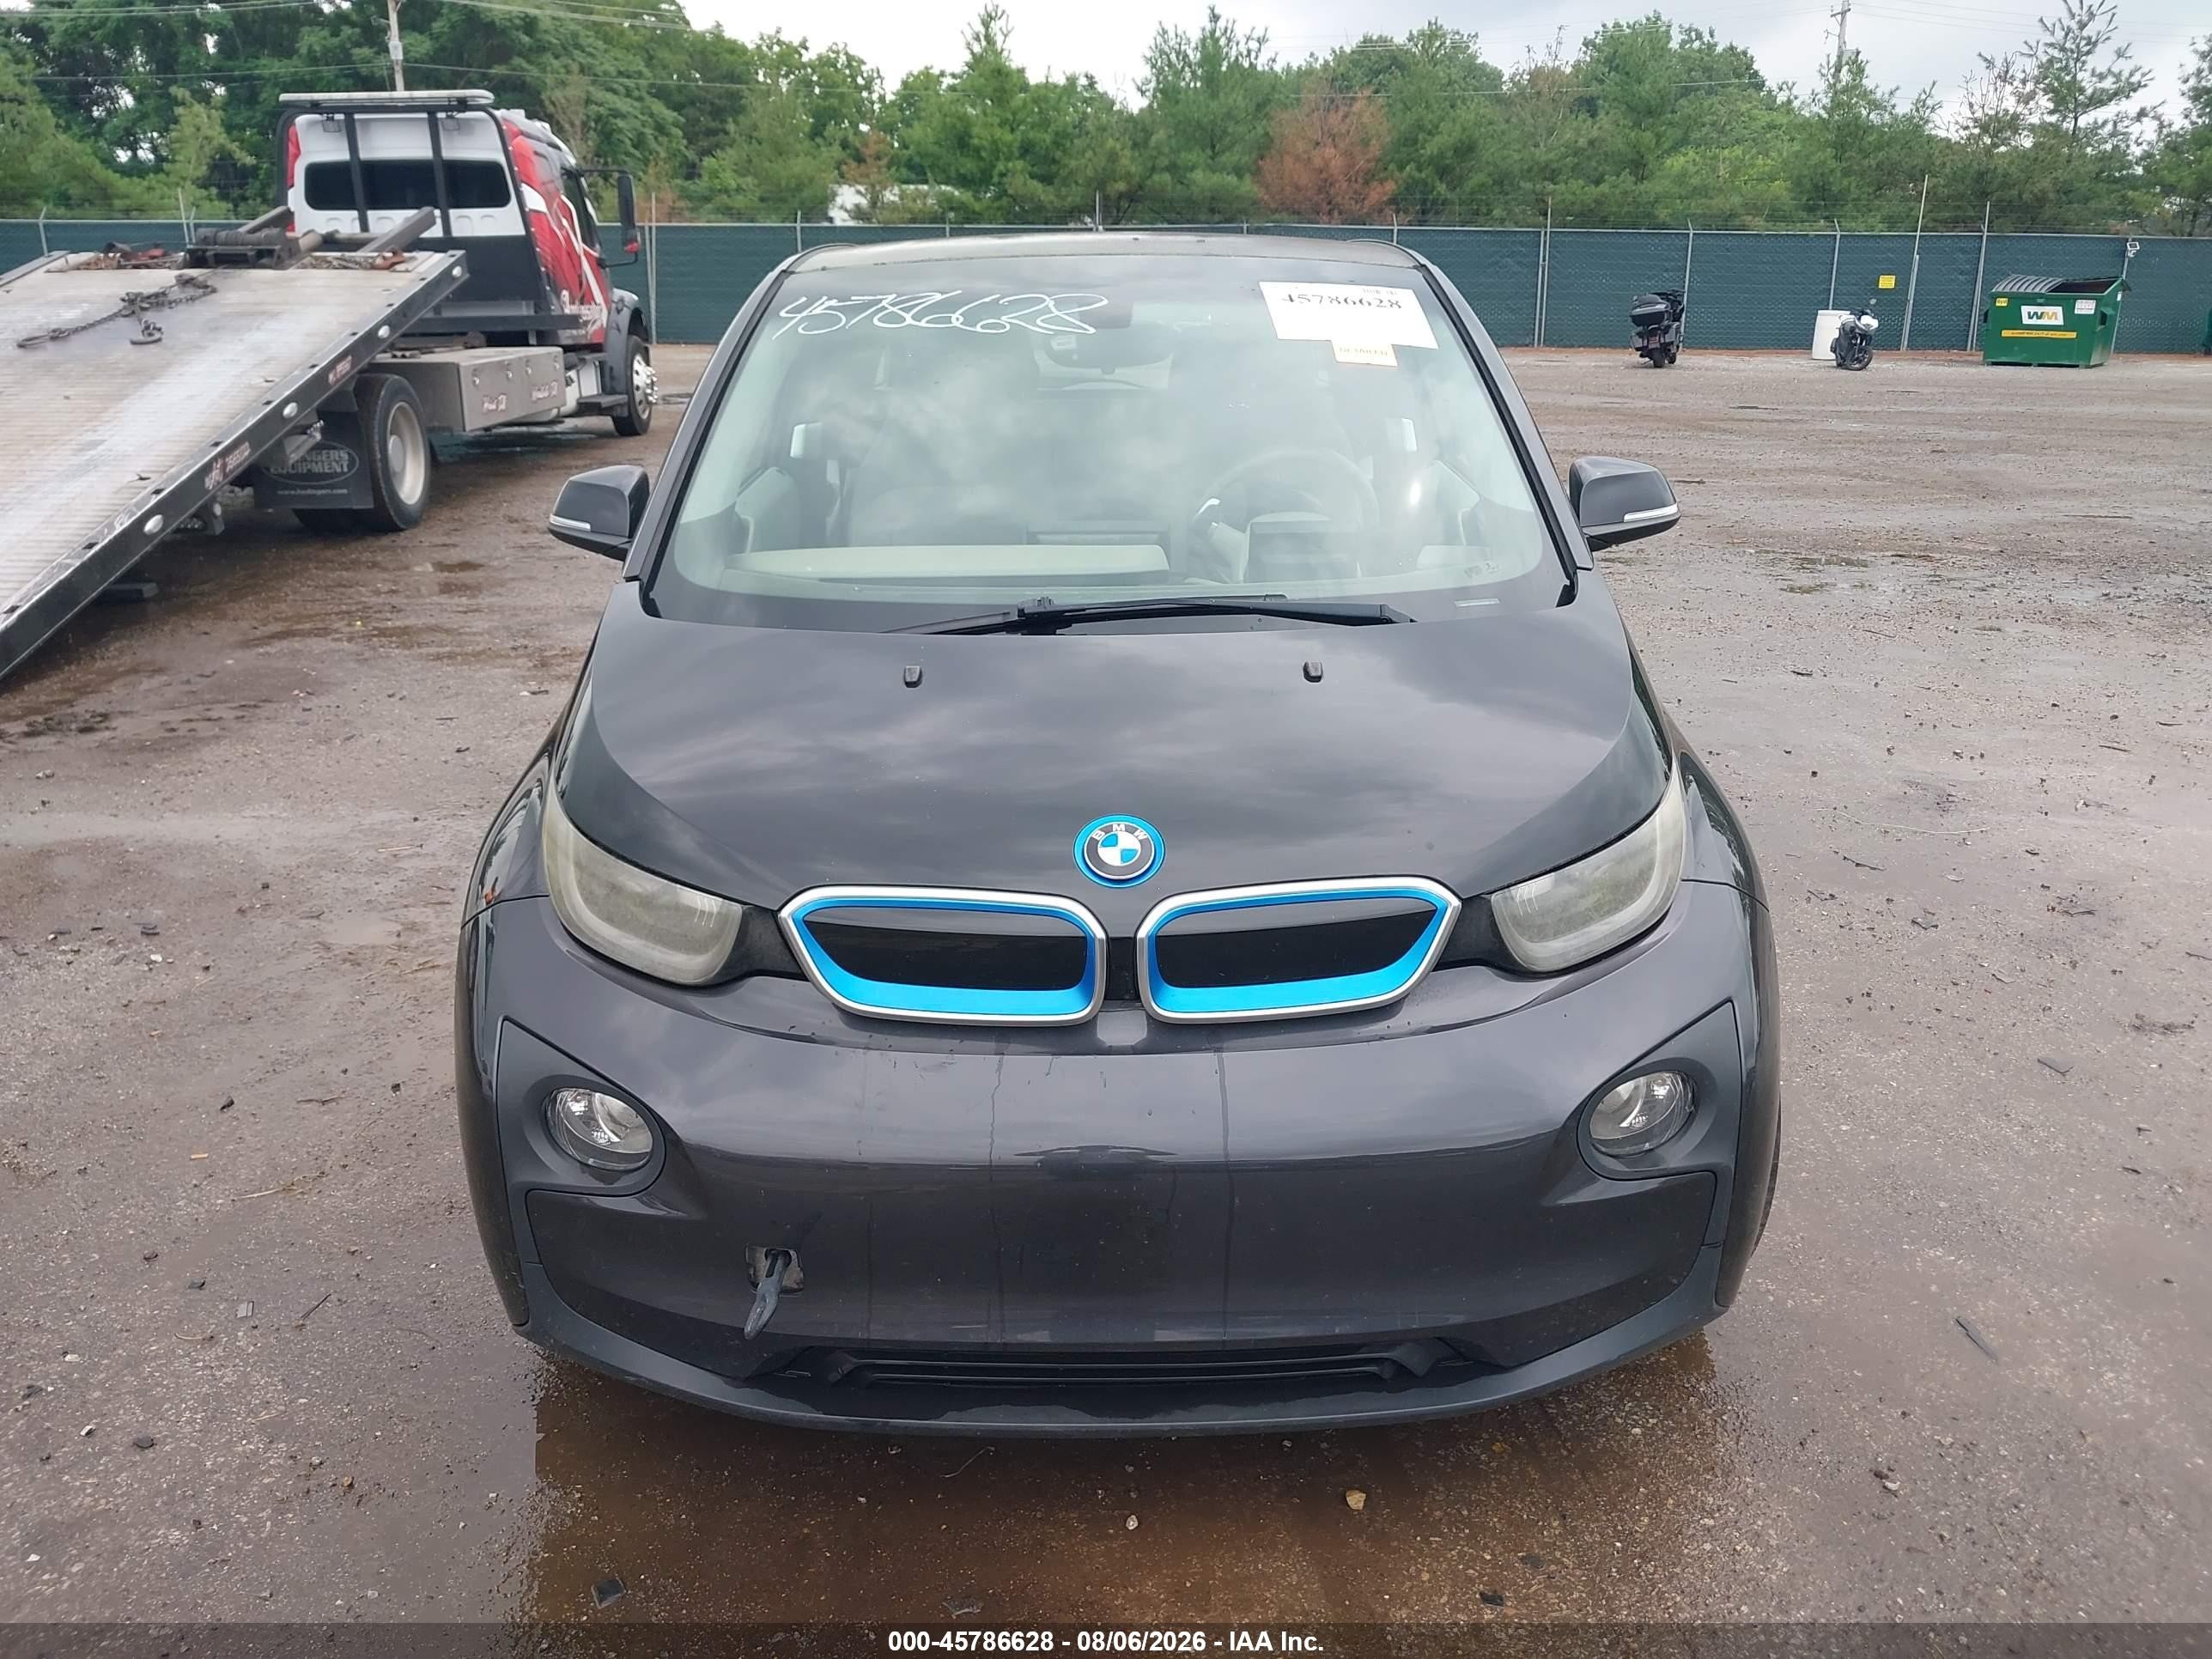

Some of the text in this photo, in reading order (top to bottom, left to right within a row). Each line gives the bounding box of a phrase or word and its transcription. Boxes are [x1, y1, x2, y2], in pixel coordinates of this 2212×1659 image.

[1282, 293, 1402, 310] 45786628
[772, 290, 1109, 340] 45786628
[2027, 311, 2059, 321] WM
[1091, 823, 1148, 842] BMW
